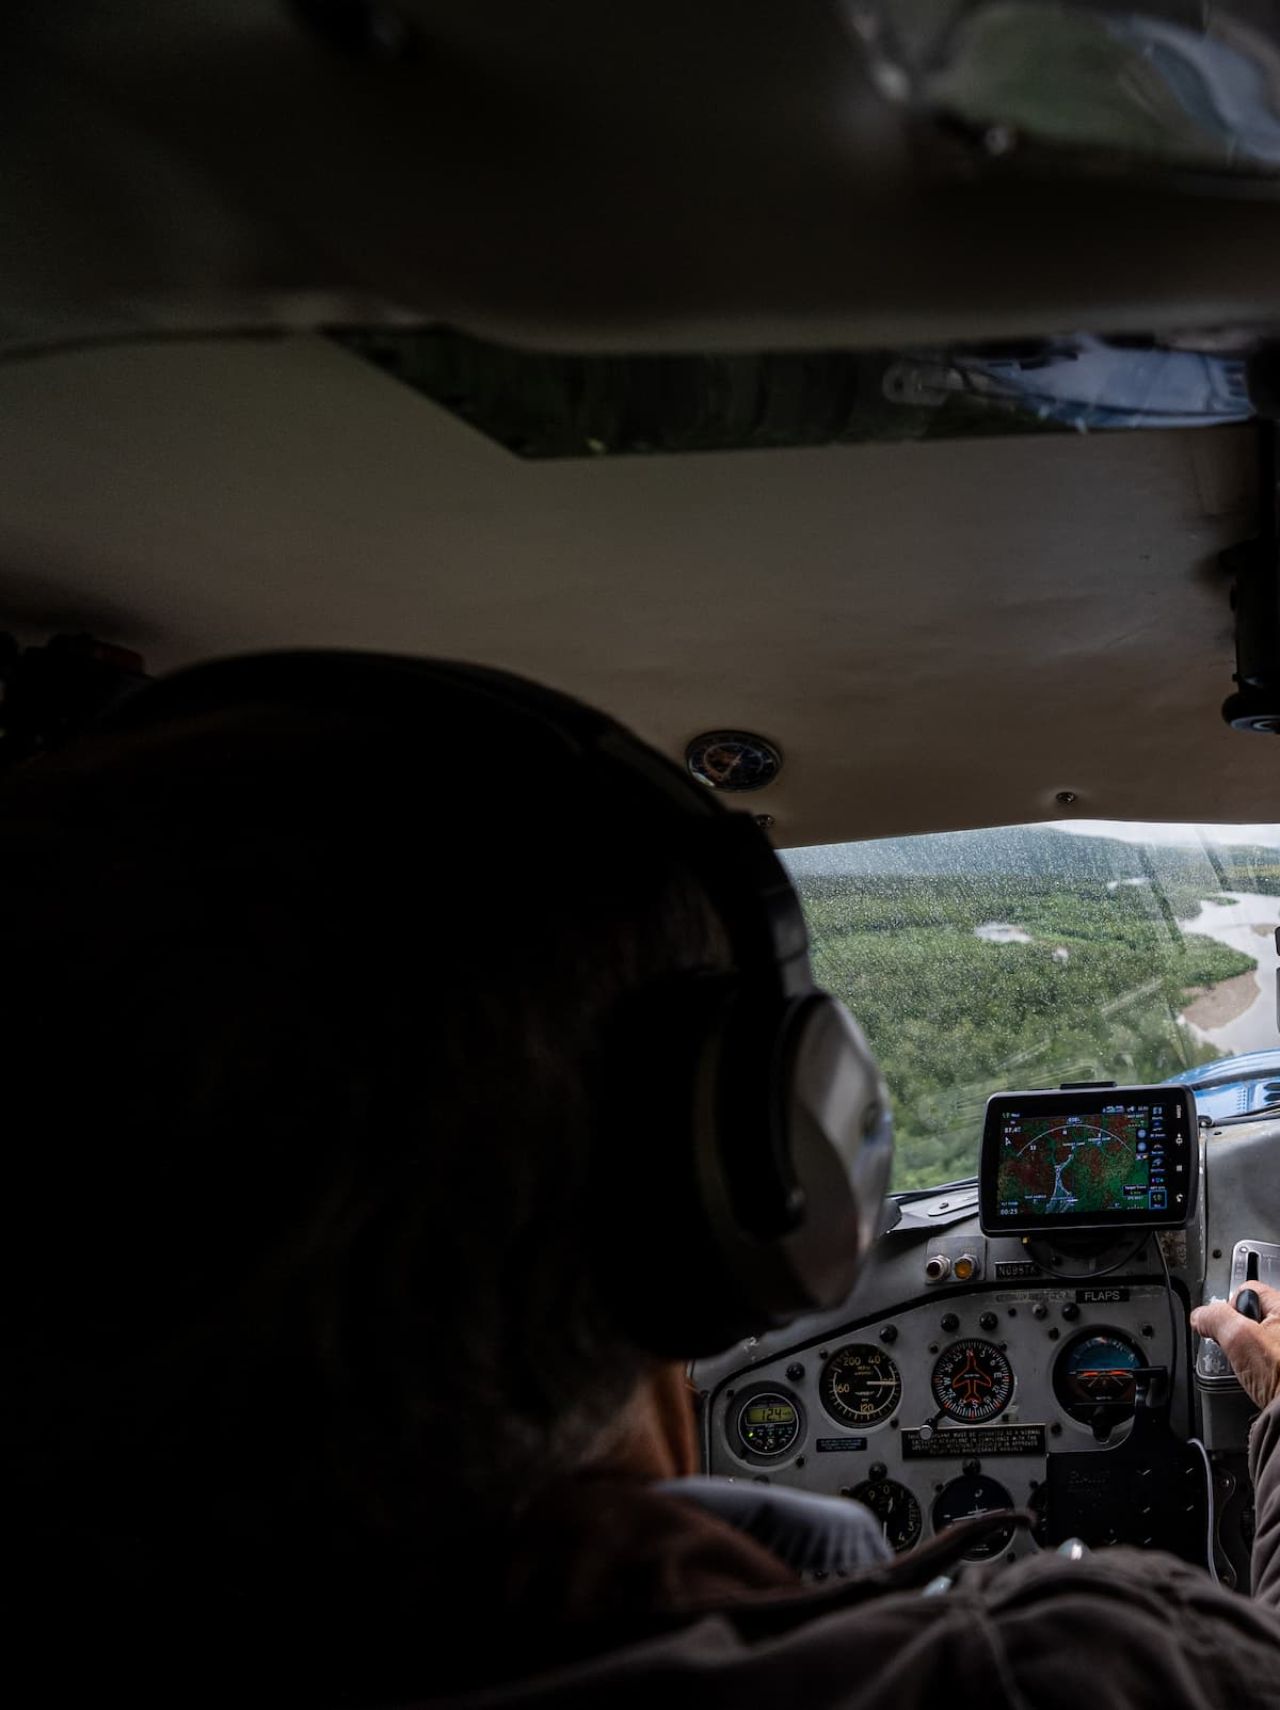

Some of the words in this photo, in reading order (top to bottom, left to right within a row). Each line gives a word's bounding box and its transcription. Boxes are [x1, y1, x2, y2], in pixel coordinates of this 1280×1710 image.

[1084, 1290, 1121, 1301] FLAPS
[843, 1356, 861, 1367] 200
[867, 1355, 881, 1364] 40
[860, 1402, 875, 1413] 120
